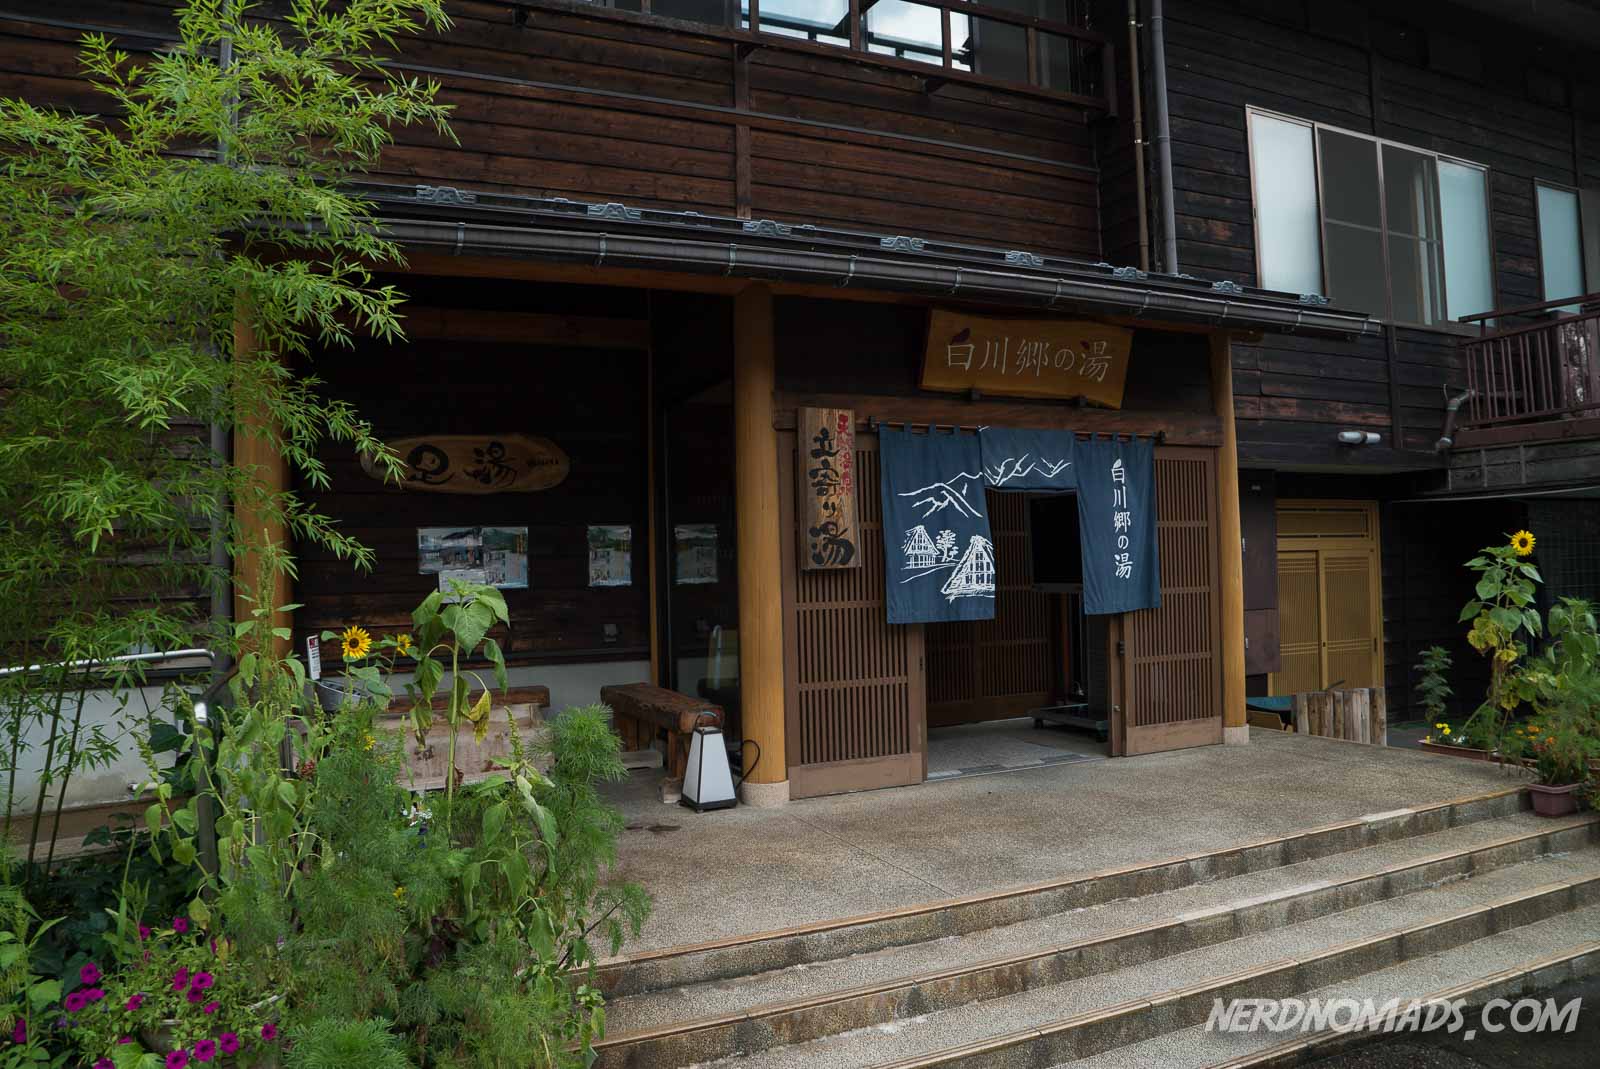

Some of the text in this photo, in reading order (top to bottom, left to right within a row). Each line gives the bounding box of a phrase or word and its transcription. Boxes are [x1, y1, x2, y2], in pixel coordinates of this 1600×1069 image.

[947, 328, 1113, 382] 白川郷の湯
[1111, 458, 1134, 580] 白川郷の湯
